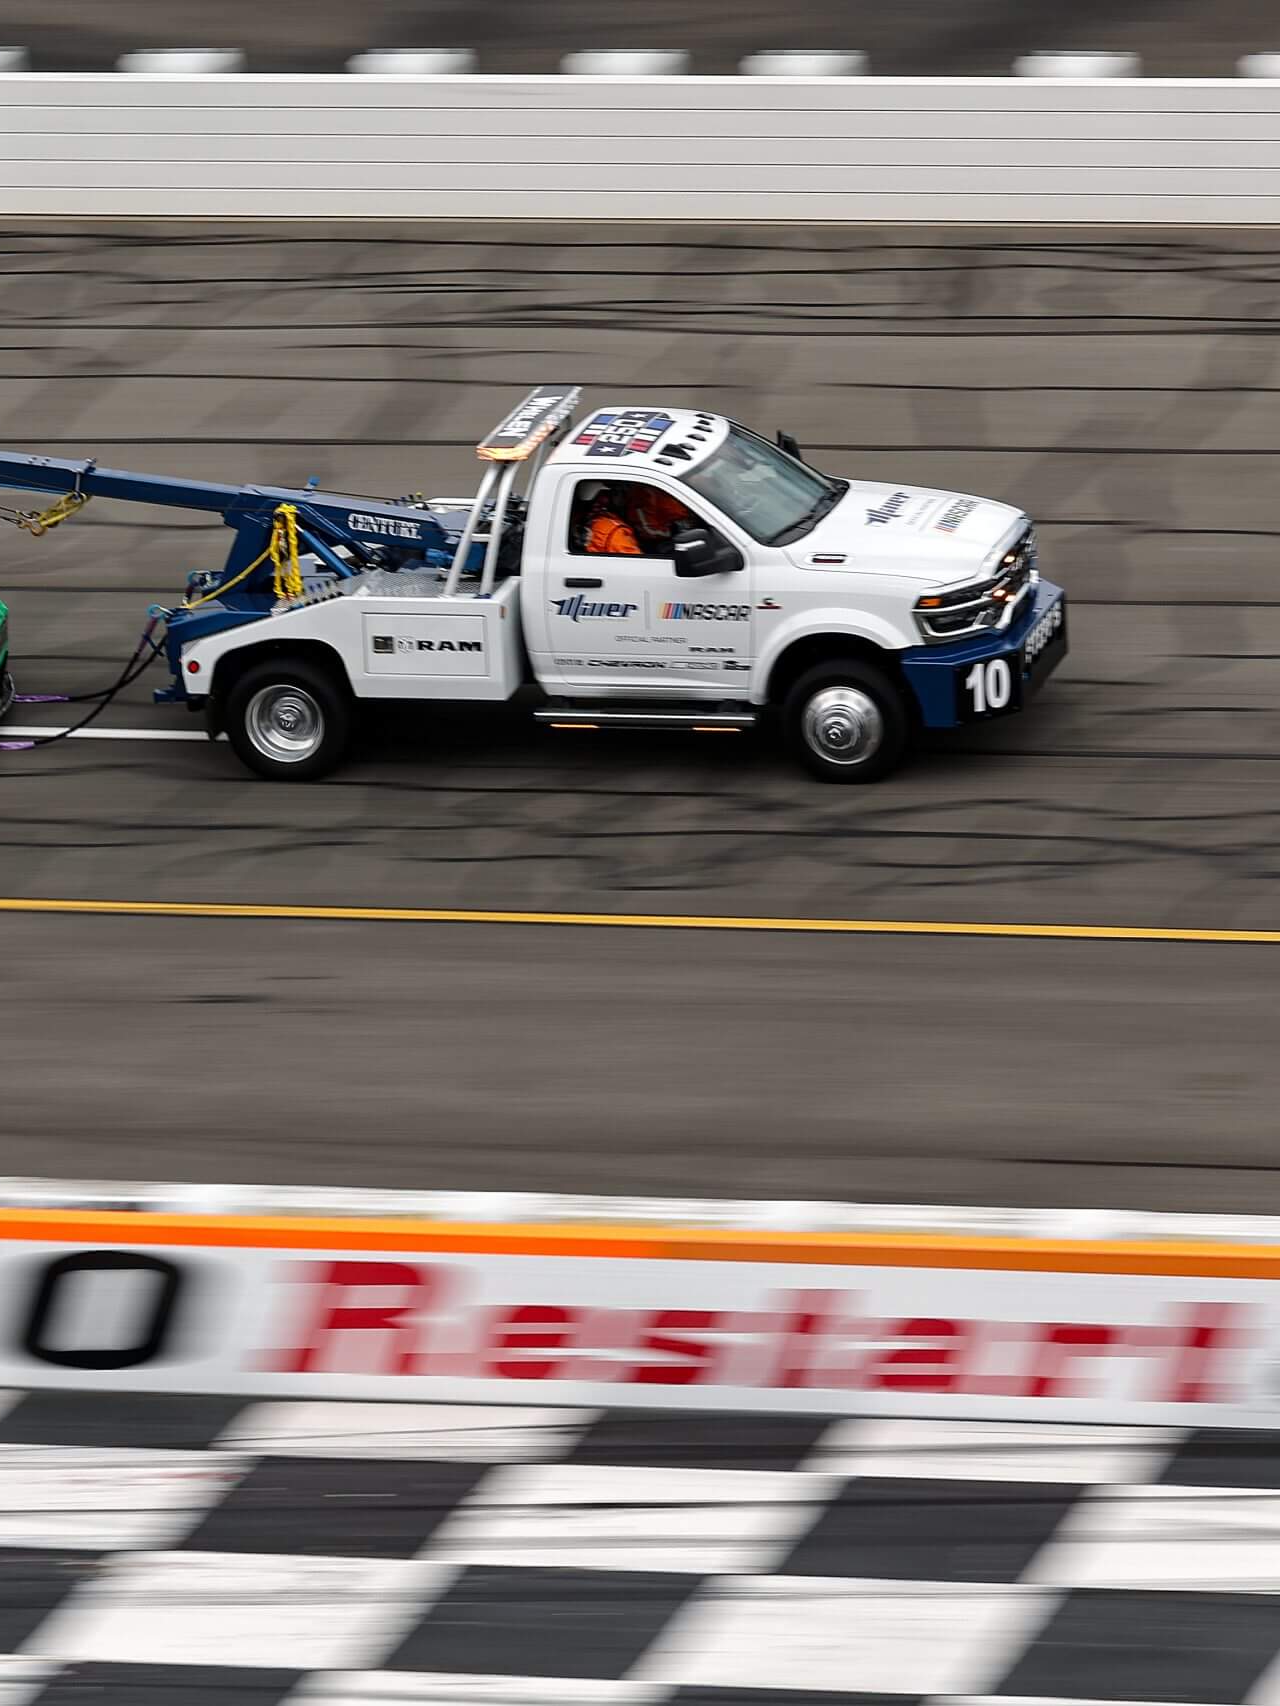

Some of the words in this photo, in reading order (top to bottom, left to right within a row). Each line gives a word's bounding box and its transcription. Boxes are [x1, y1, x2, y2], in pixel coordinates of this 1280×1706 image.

[597, 419, 647, 444] 250
[680, 601, 753, 622] NASCAR
[416, 639, 483, 652] RAM
[966, 659, 1011, 713] 10
[260, 1257, 1235, 1403] Restart
